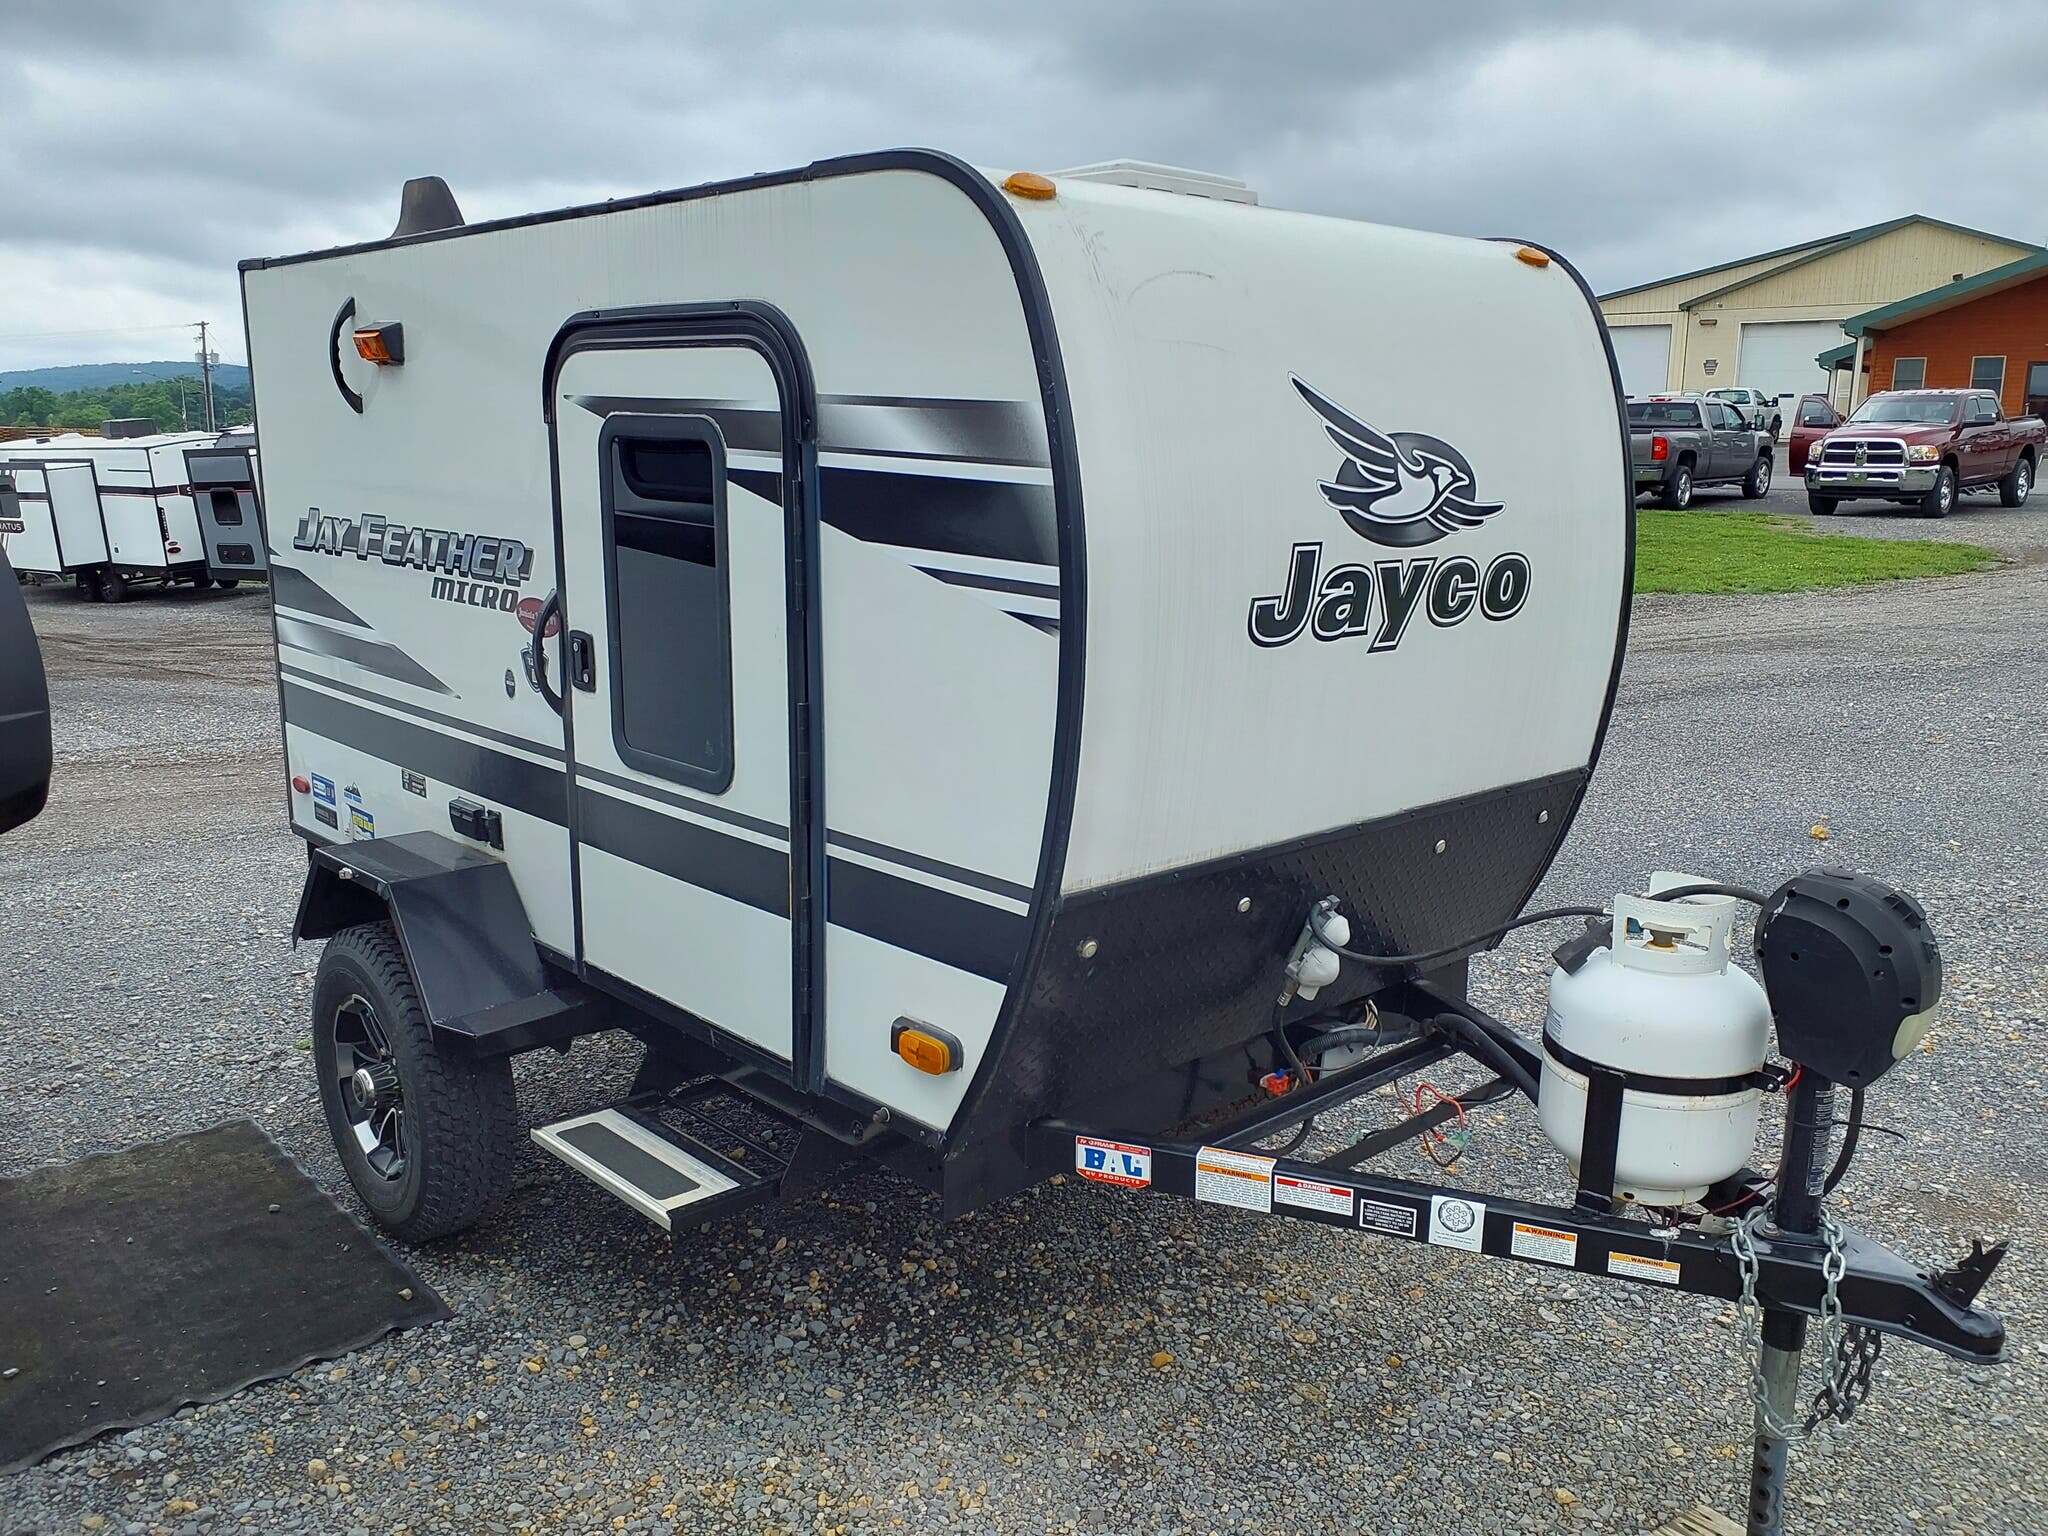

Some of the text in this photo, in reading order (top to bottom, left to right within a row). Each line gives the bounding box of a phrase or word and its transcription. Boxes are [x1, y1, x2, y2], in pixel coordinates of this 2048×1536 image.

[293, 507, 528, 587] JAY FEATHER
[431, 576, 519, 614] MICRO
[1247, 541, 1532, 655] Jayco
[1084, 1147, 1143, 1178] BAL
[1098, 1172, 1140, 1185] PRODUCTS
[1221, 1168, 1252, 1180] WARNING
[1302, 1183, 1331, 1193] DANGER
[1530, 1227, 1566, 1240] WARNING
[1630, 1256, 1664, 1268] WARNING
